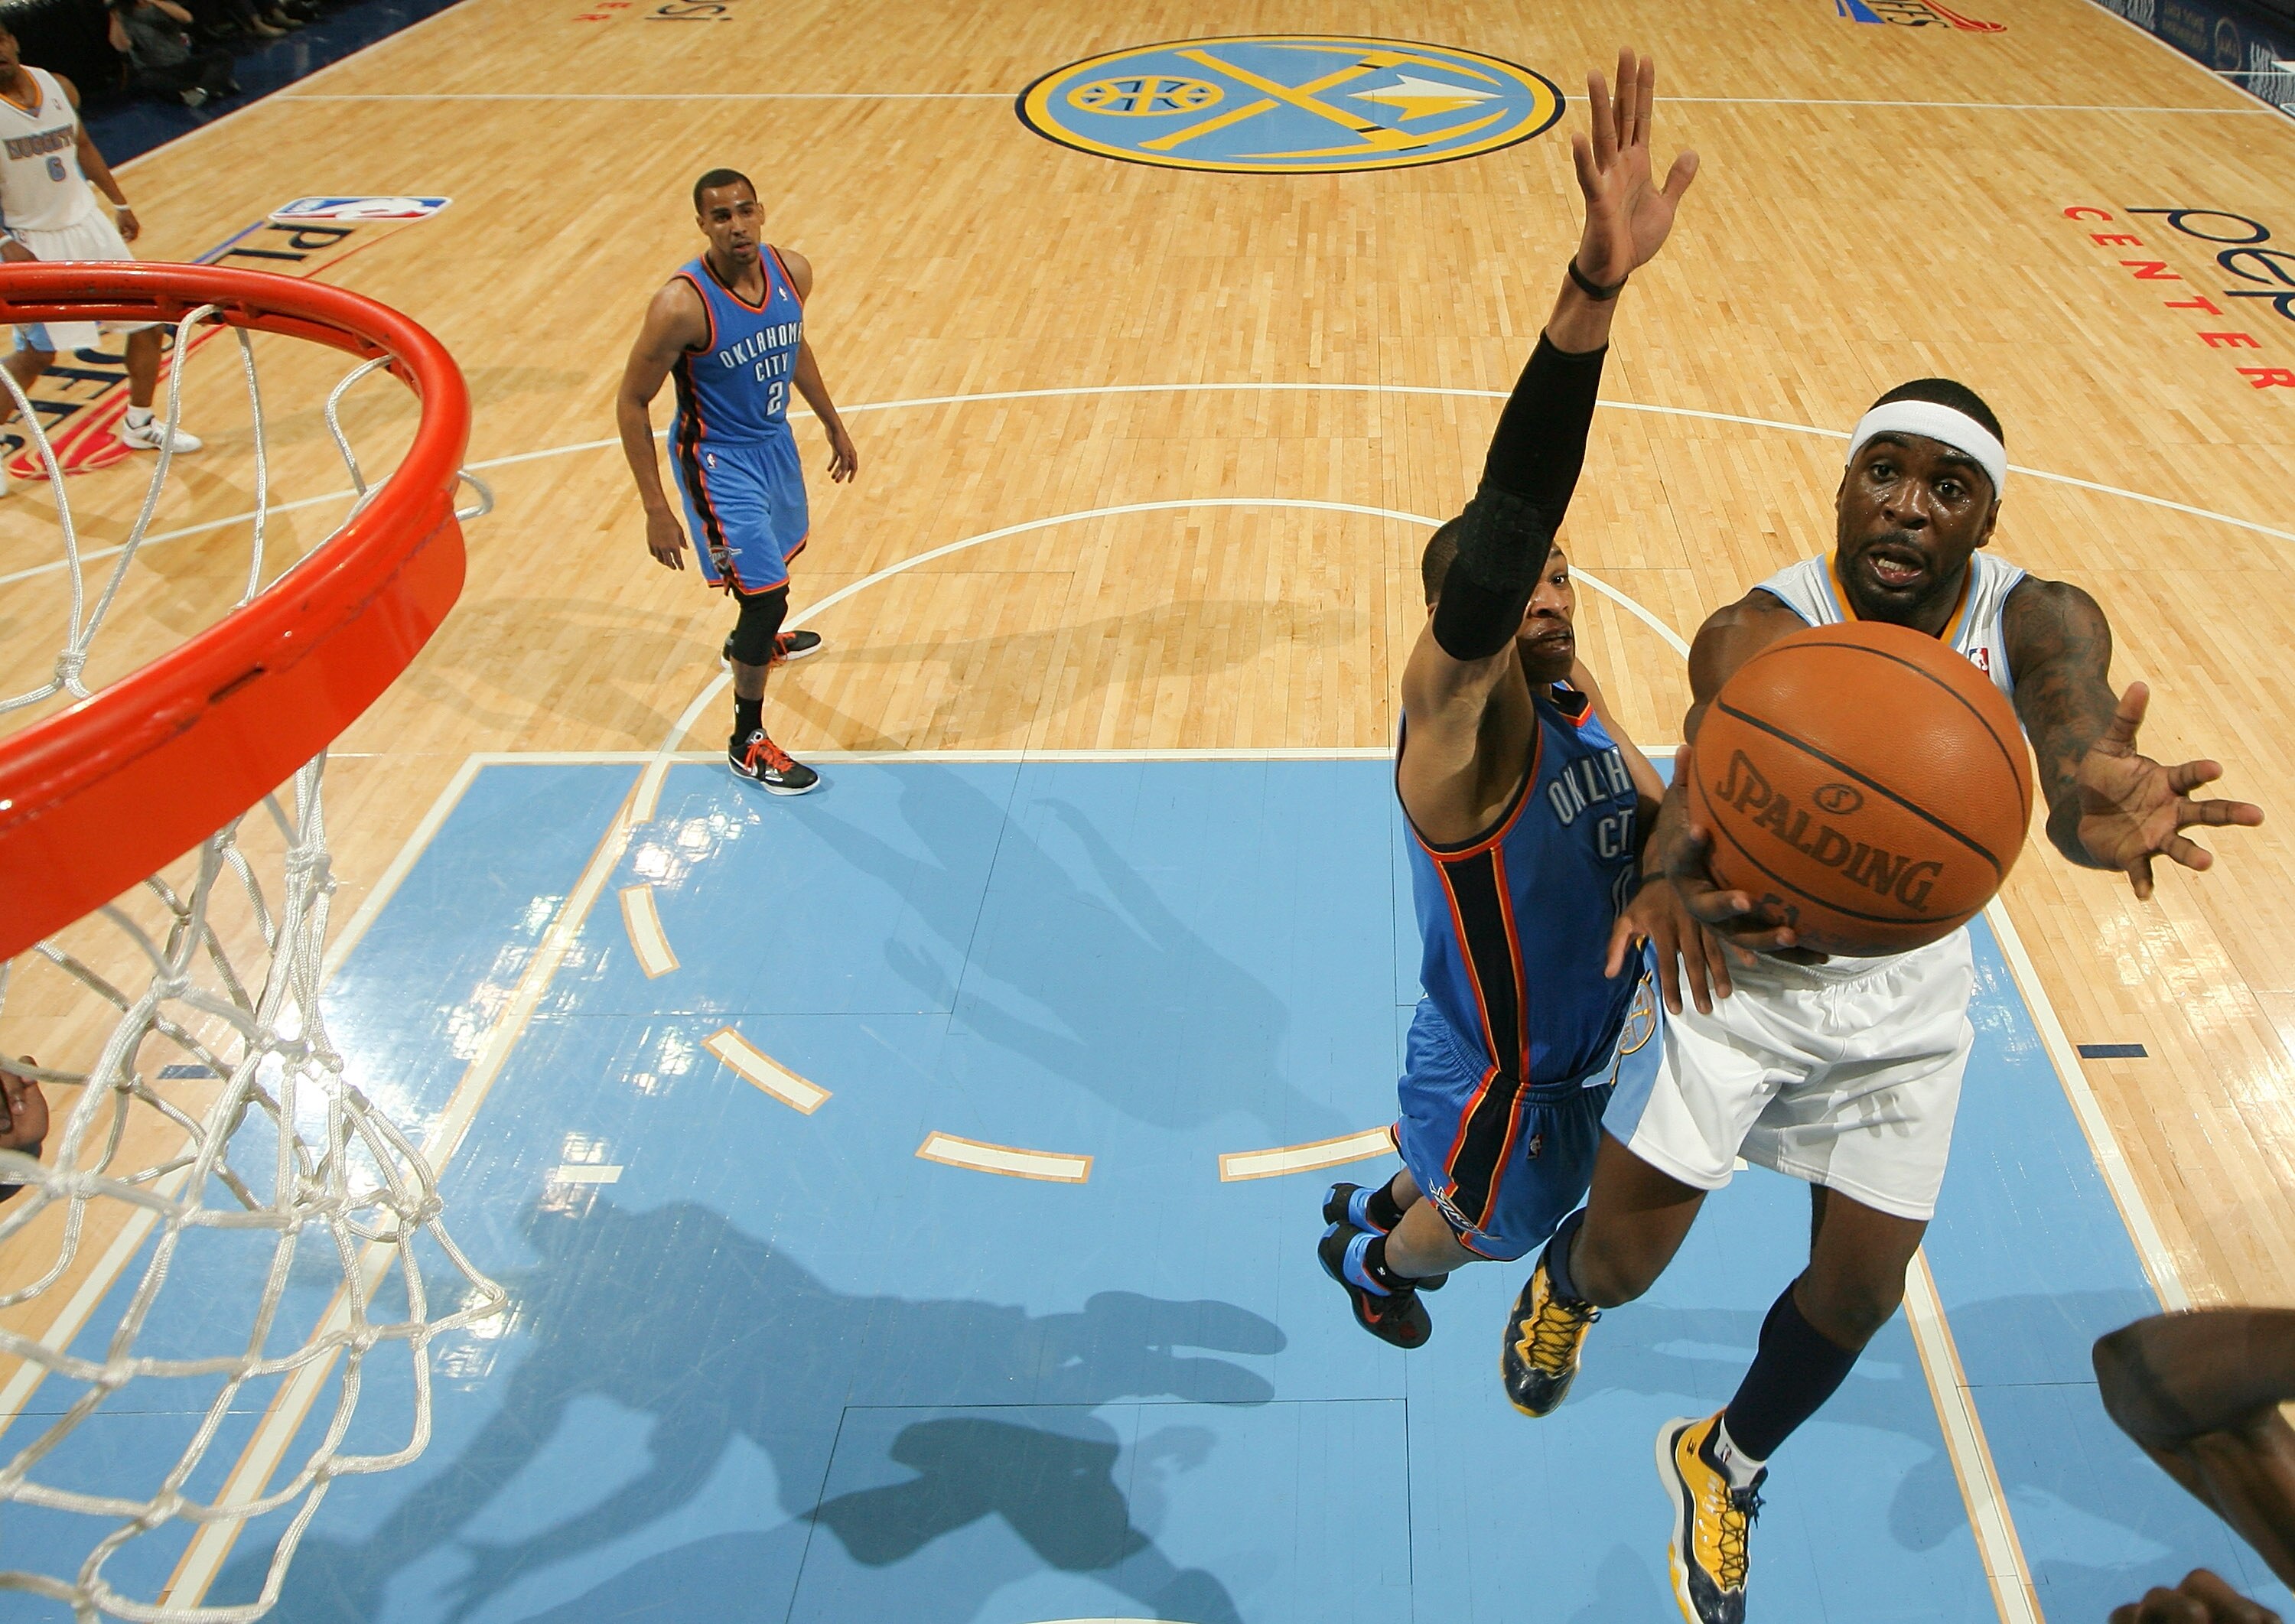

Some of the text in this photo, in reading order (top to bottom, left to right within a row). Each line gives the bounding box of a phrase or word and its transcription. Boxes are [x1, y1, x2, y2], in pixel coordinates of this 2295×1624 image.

[2, 123, 74, 160] NUGGET
[47, 155, 67, 181] 6
[2064, 206, 2295, 389] CENTER
[754, 352, 789, 382] CITY
[767, 381, 783, 416] 2
[1714, 748, 1944, 913] SPALDING
